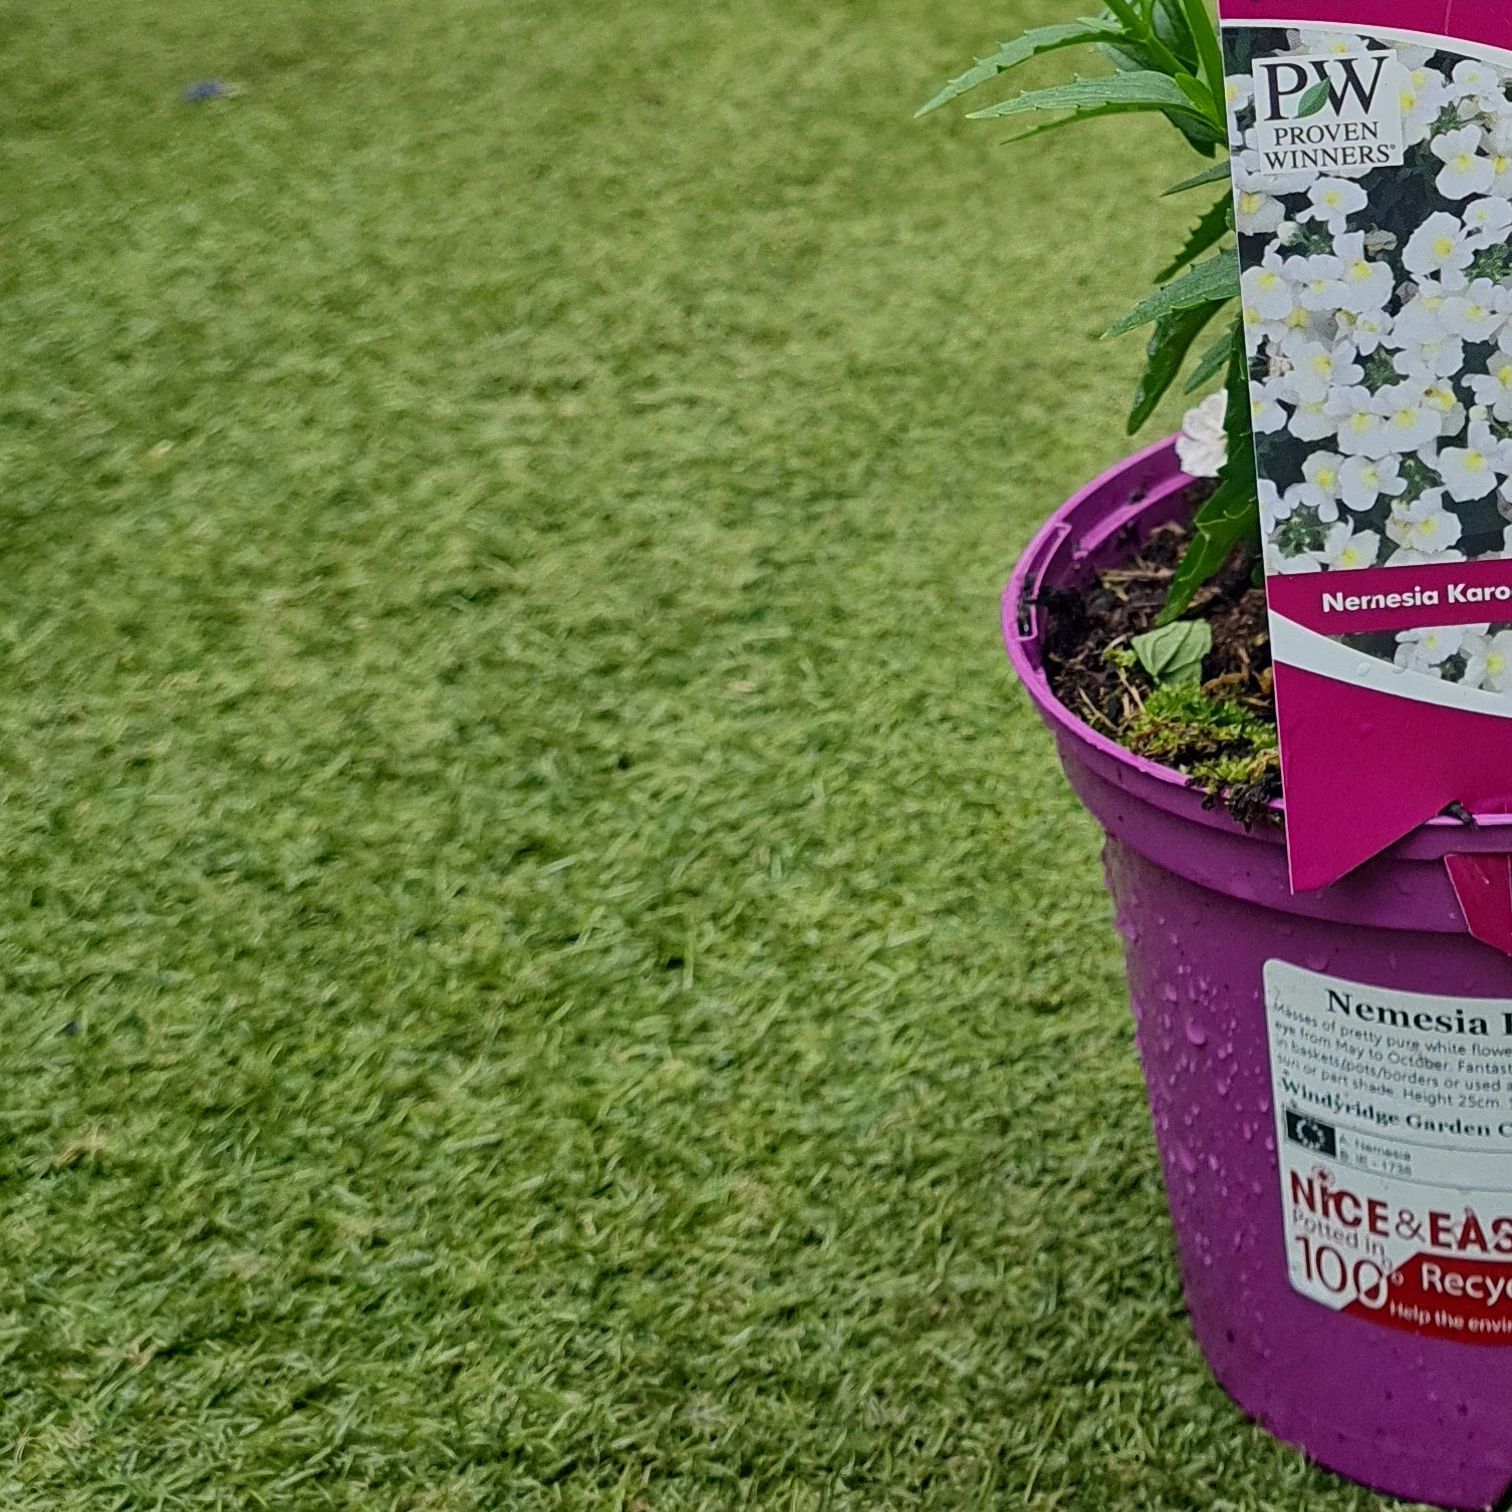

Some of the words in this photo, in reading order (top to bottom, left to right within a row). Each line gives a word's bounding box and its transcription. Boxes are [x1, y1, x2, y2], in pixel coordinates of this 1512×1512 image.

[1259, 55, 1389, 121] PW
[1274, 121, 1379, 147] PROVEN
[1326, 988, 1491, 1036] Nemesia
[1425, 1041, 1467, 1056] white
[1464, 1077, 1501, 1092] used
[1405, 1112, 1491, 1137] Garden
[1292, 1208, 1359, 1250] Potted
[1365, 1236, 1387, 1258] in
[1389, 1298, 1432, 1327] Help
[1434, 1307, 1465, 1331] the
